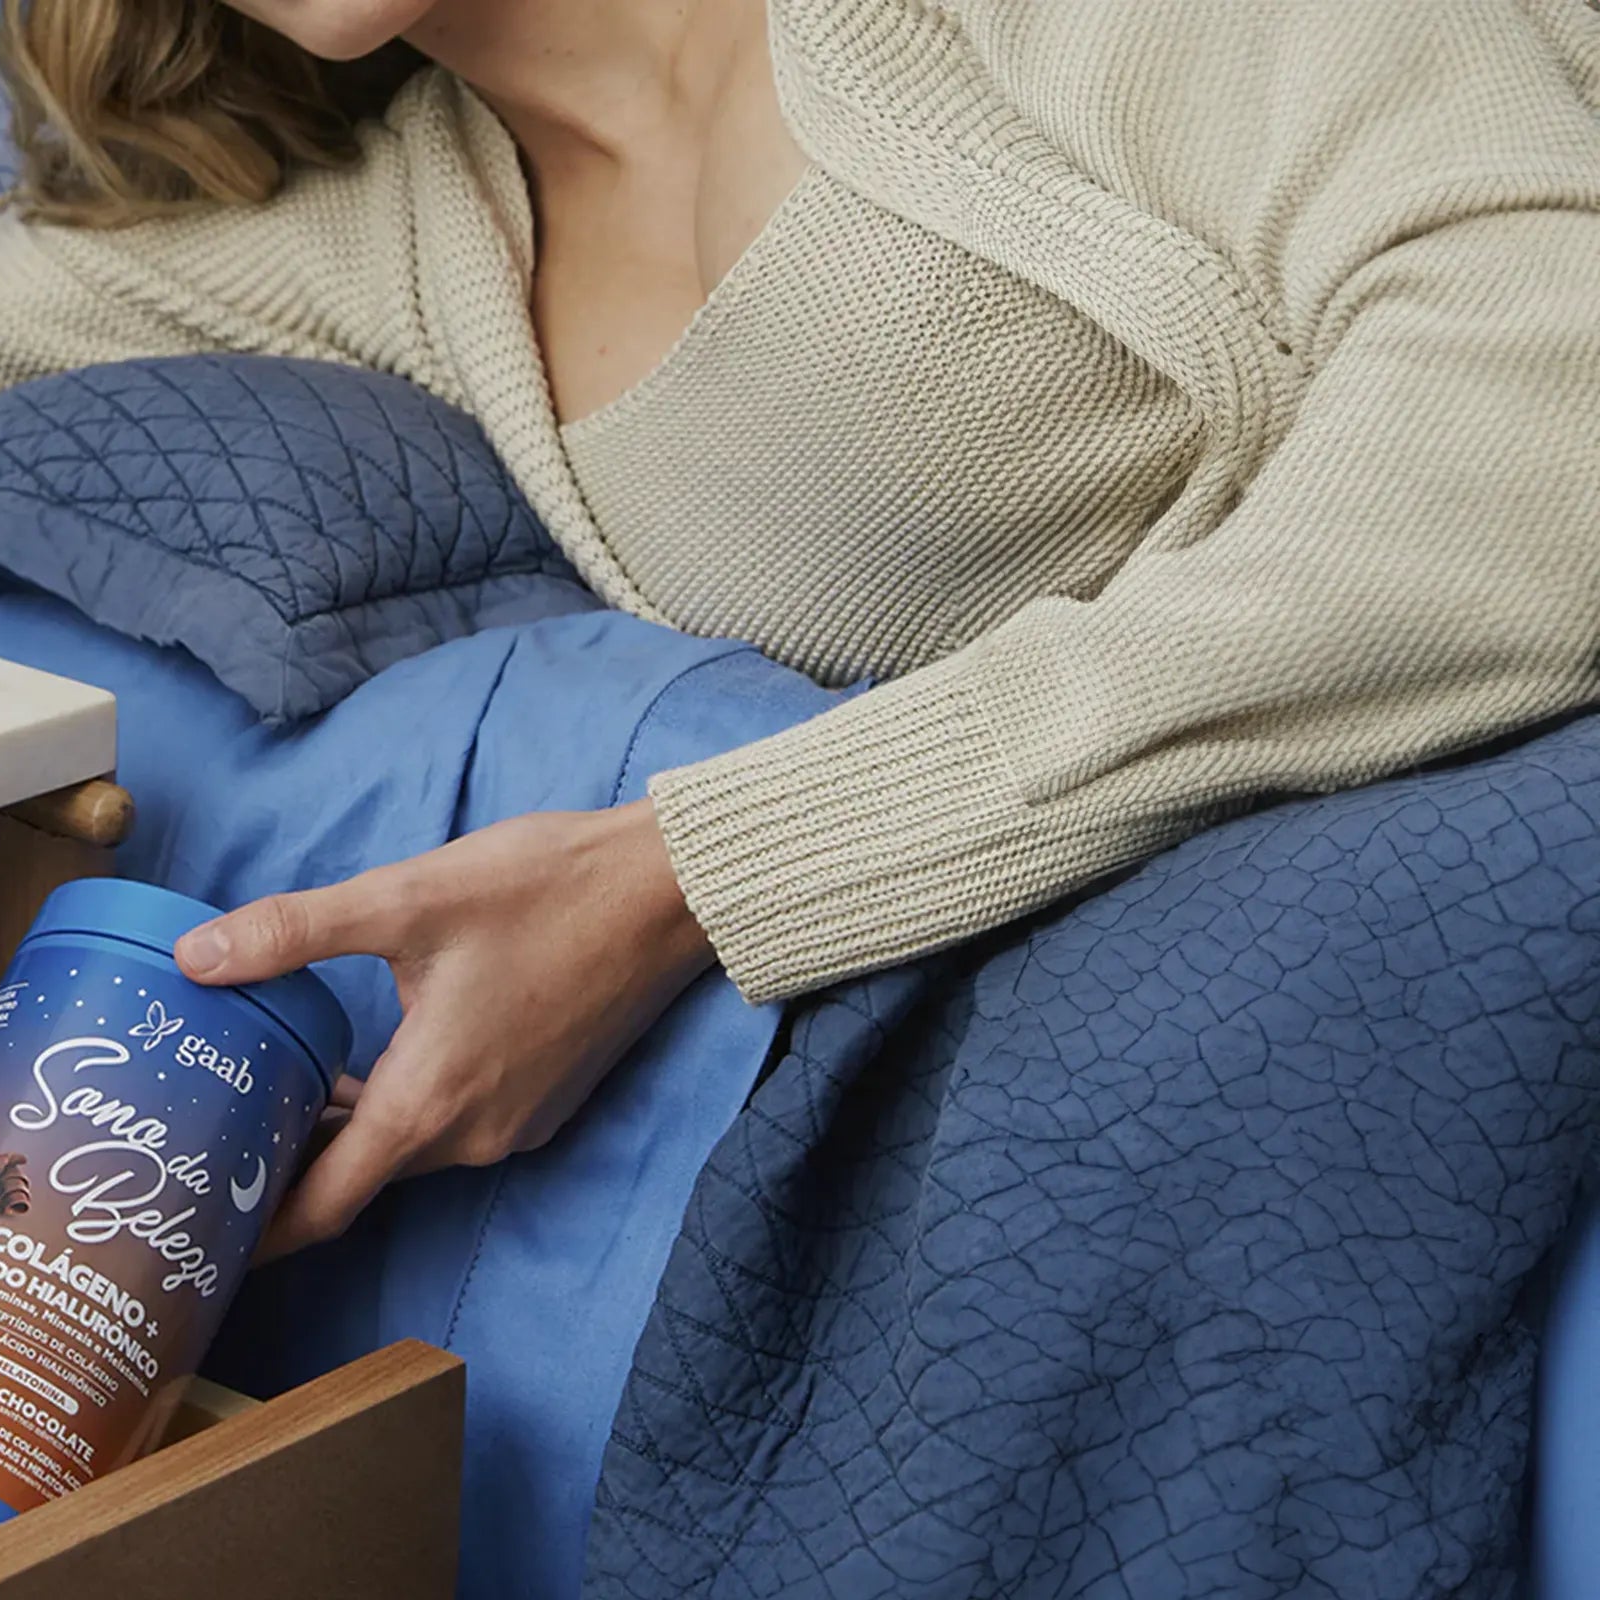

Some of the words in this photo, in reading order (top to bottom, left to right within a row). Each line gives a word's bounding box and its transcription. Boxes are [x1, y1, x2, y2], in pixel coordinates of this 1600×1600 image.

[175, 1034, 254, 1094] gaab
[9, 1037, 168, 1149] Sono
[167, 1152, 211, 1195] da
[50, 1140, 219, 1297] Beleza
[25, 1275, 159, 1379] HIALURÔNICO
[41, 1308, 94, 1348] Minerais
[93, 1344, 103, 1354] e
[101, 1347, 150, 1398] Melatonina
[49, 1337, 65, 1354] DE
[66, 1347, 119, 1392] COLÁGENO
[36, 1353, 107, 1408] HIALURÔNICO
[12, 1435, 63, 1478] COLÁGENO,
